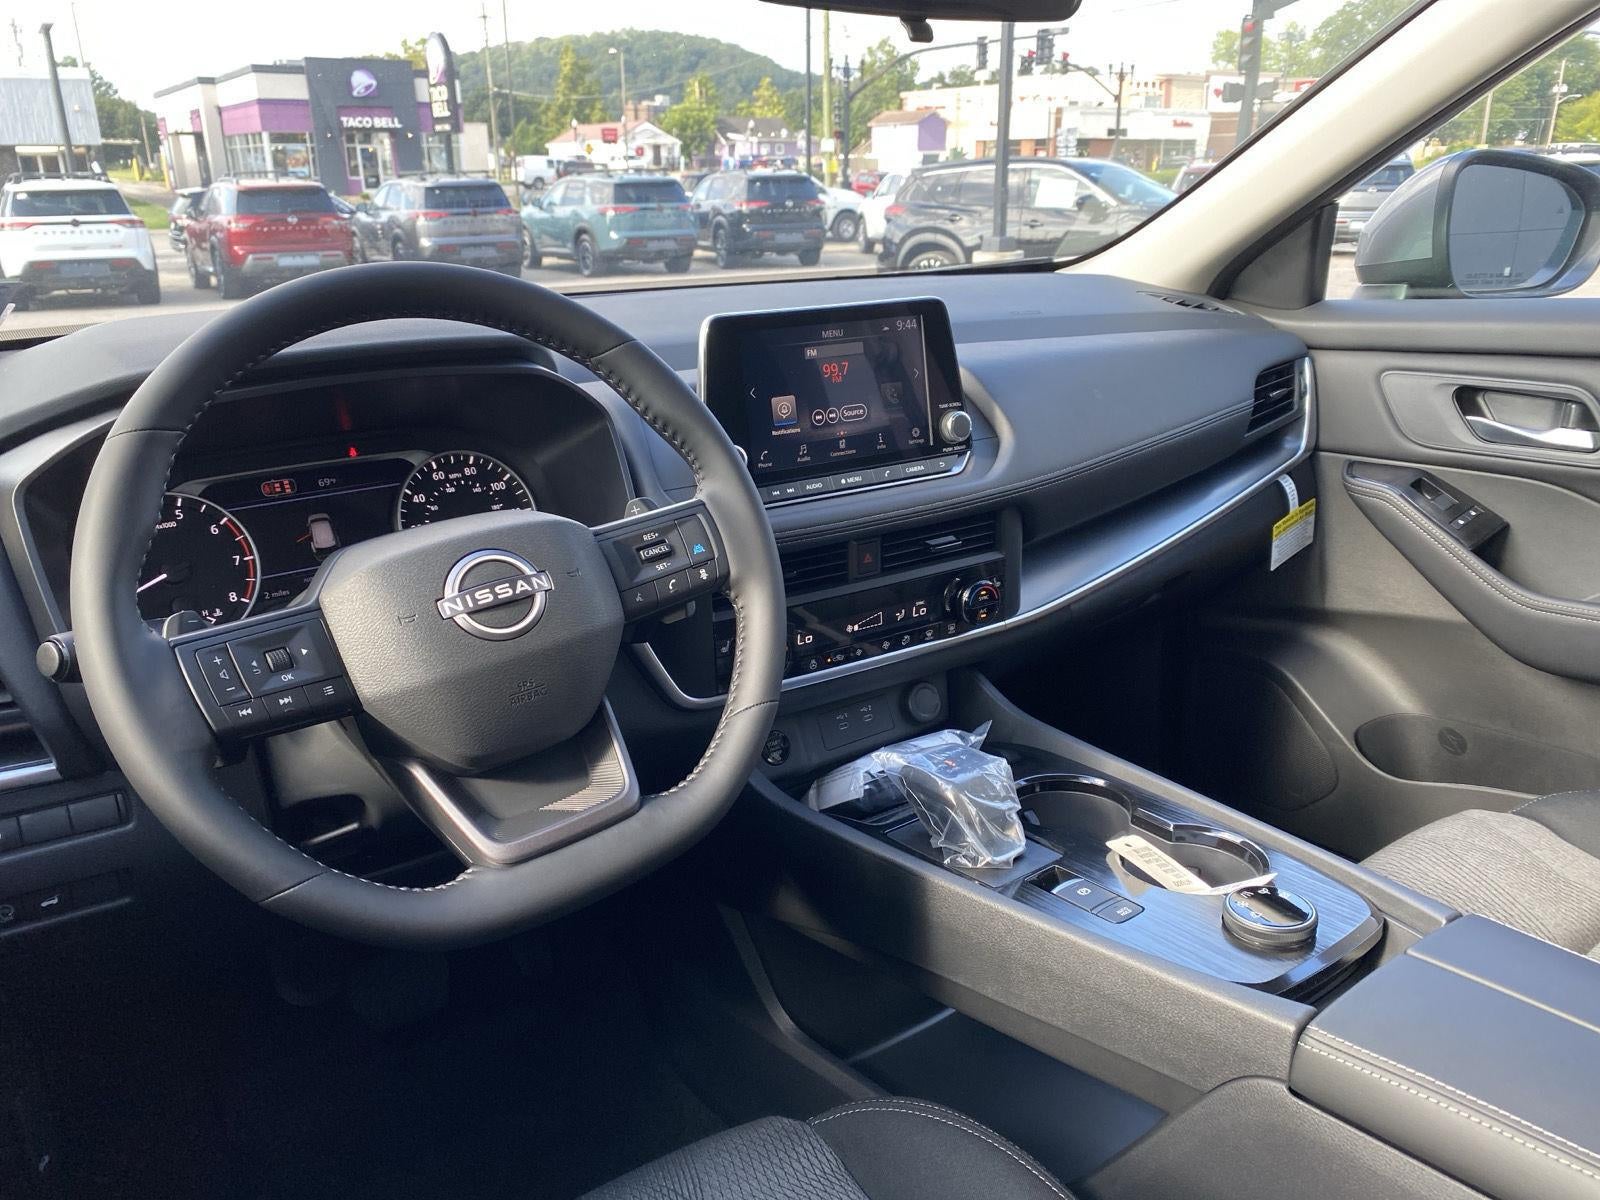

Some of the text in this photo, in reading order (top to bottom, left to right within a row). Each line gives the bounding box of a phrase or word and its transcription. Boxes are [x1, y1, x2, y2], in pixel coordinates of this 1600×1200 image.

[340, 116, 402, 129] TACO BELL
[896, 319, 917, 331] 9:44
[821, 328, 844, 339] MENU
[806, 348, 818, 357] FM
[822, 361, 849, 378] 99.7
[843, 407, 865, 417] Source
[464, 466, 477, 476] 80
[905, 465, 925, 473] CAMERA
[432, 471, 446, 481] 60
[846, 475, 863, 484] MENU
[490, 481, 506, 491] 100
[805, 482, 823, 490] AUDIO
[412, 493, 426, 503] 40
[174, 509, 184, 520] 5
[210, 524, 220, 535] 6
[643, 532, 659, 541] RES+
[644, 545, 670, 557] CANCEL
[232, 555, 240, 566] 7
[228, 592, 238, 602] 8
[264, 590, 290, 599] 2 miles
[441, 574, 550, 617] NISSAN
[912, 606, 927, 618] Lo
[797, 632, 814, 646] Lo
[281, 672, 294, 682] OK
